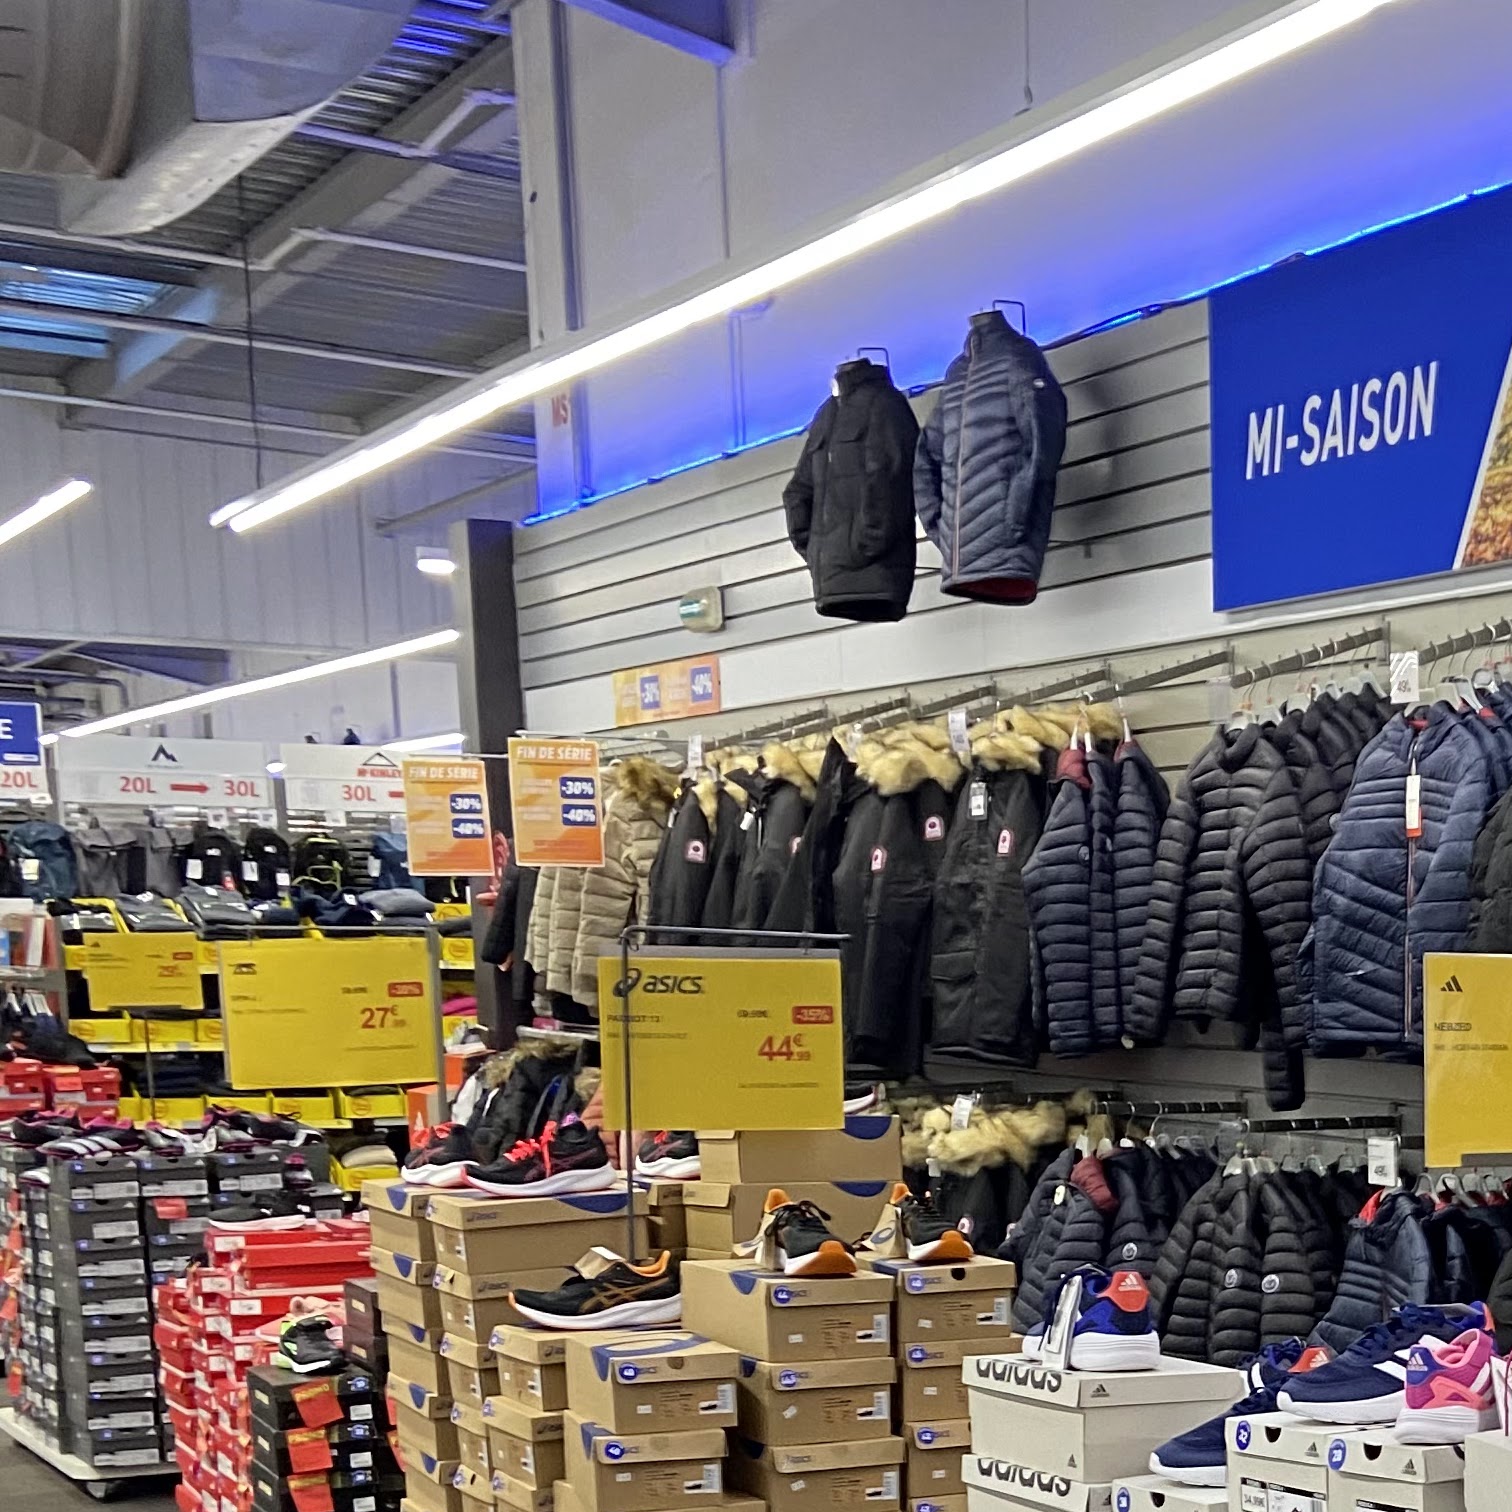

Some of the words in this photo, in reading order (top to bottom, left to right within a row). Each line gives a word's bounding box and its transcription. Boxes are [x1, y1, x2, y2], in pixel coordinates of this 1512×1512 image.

[1246, 361, 1438, 480] MI-SAISON
[517, 746, 536, 758] FIN
[538, 747, 555, 760] DE
[556, 744, 592, 760] SÉRIE
[409, 767, 428, 778] FIN
[430, 768, 445, 779] DE
[446, 764, 478, 779] SÉRIE
[120, 776, 157, 794] 20L
[224, 780, 260, 797] 30L
[341, 785, 376, 802] 30L
[561, 781, 594, 795] -30%
[451, 797, 483, 810] -30%
[563, 809, 596, 822] -40%
[643, 975, 703, 994] asics
